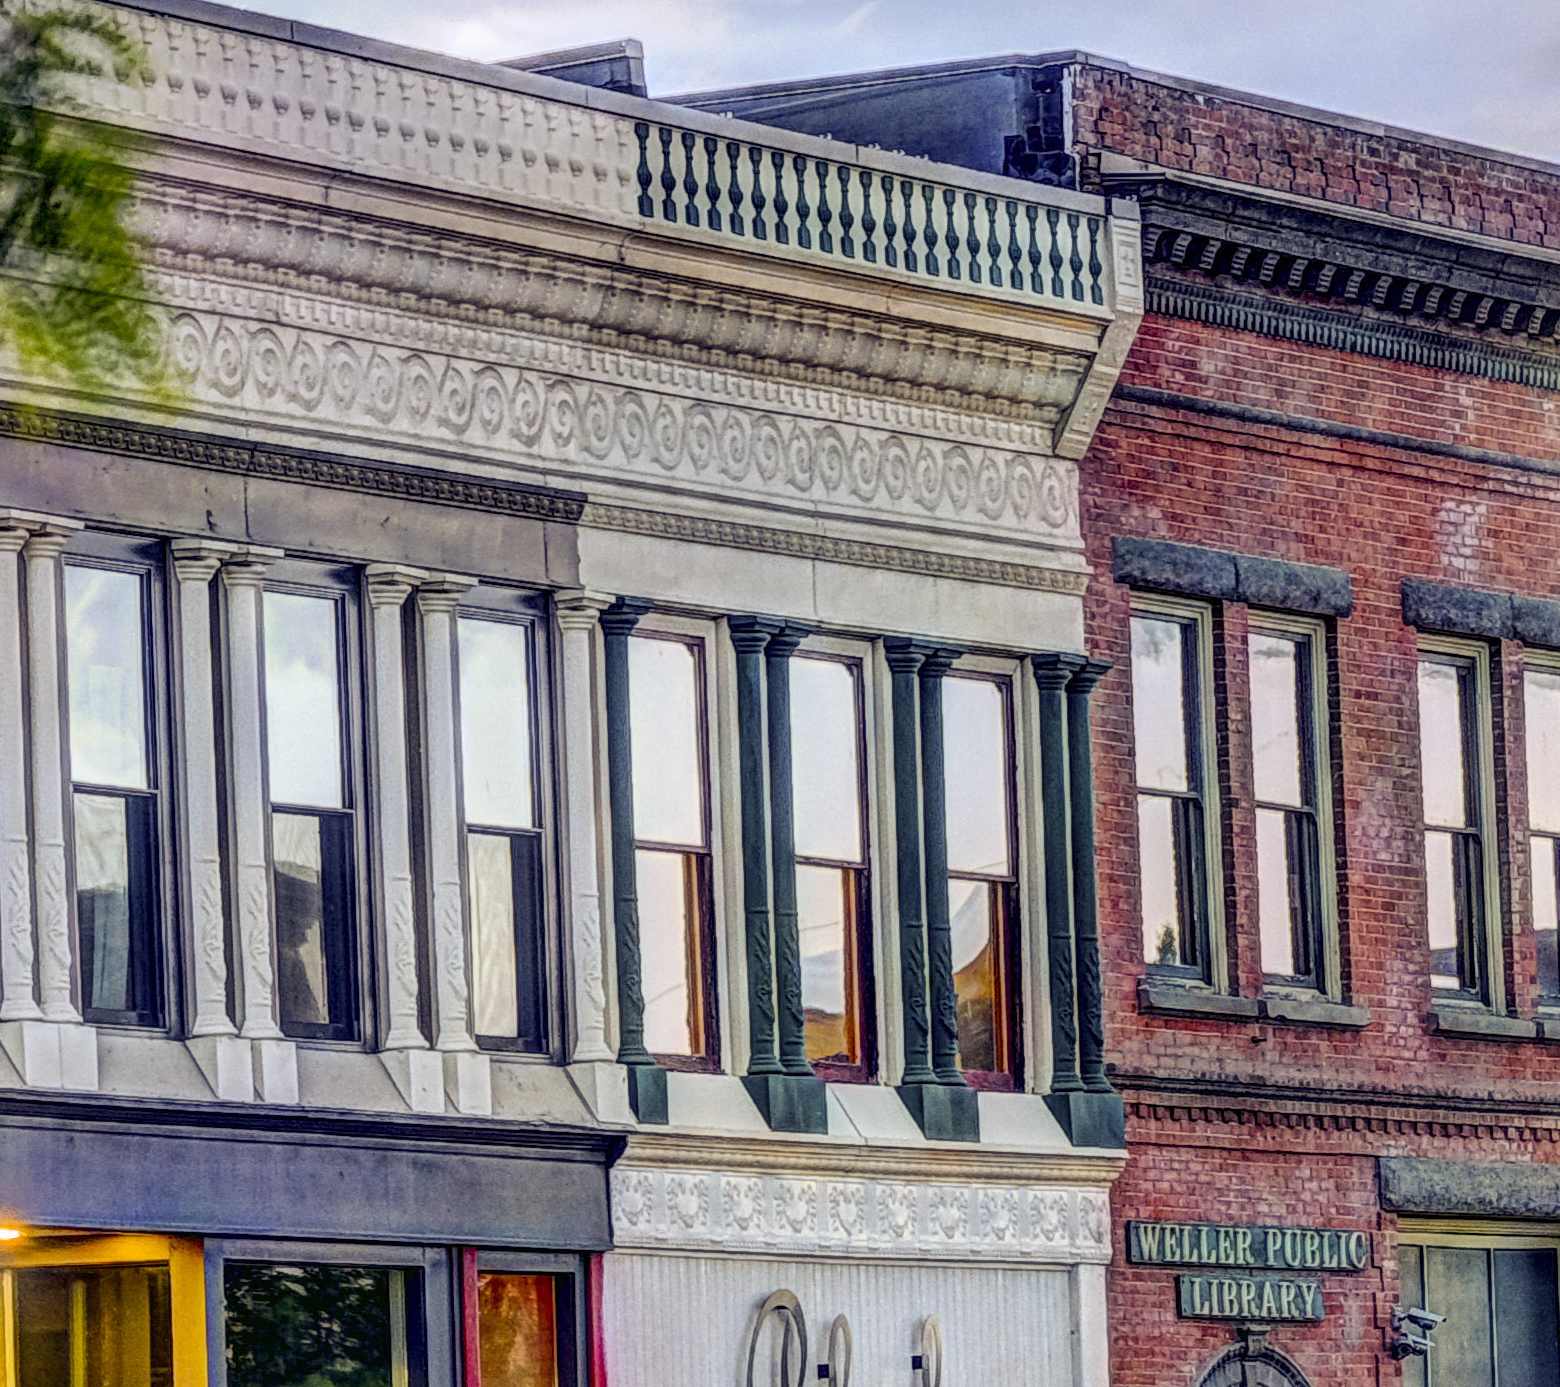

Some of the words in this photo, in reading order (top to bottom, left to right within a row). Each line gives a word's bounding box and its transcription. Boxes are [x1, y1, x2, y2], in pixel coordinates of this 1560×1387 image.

[1137, 1224, 1255, 1265] WELLER
[1263, 1229, 1367, 1269] PUBLIC
[1190, 1277, 1318, 1319] LIBRARY
